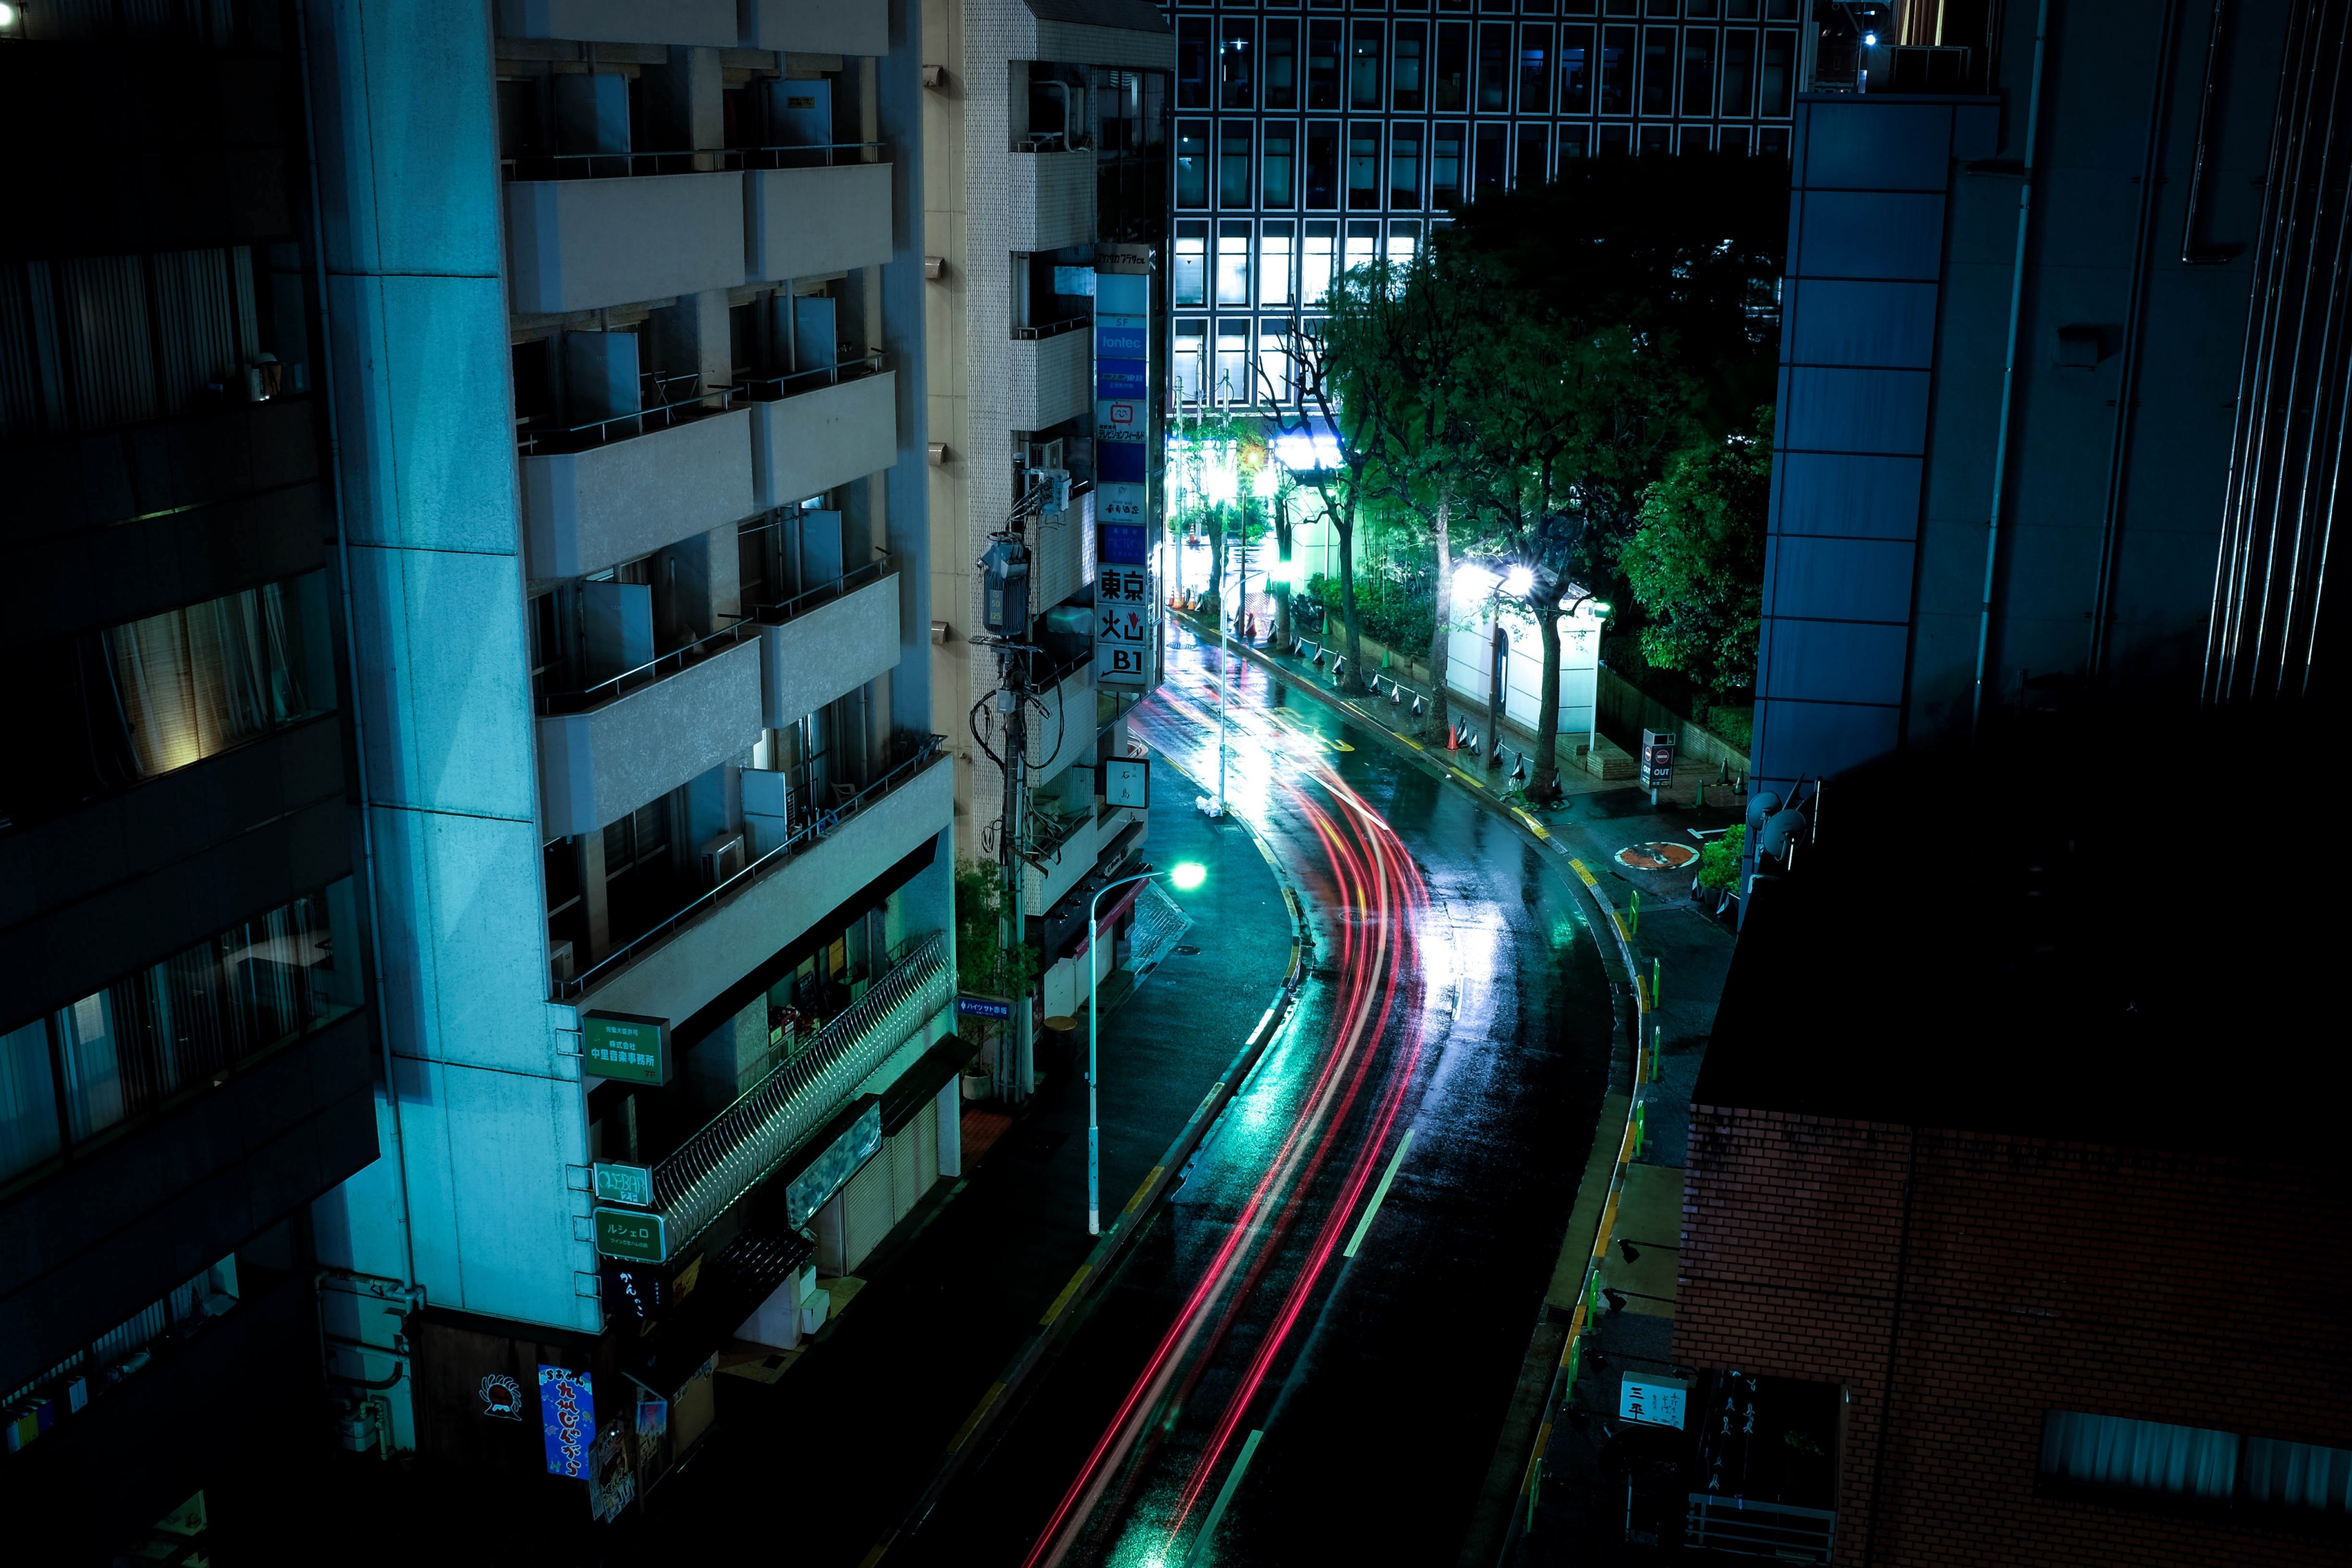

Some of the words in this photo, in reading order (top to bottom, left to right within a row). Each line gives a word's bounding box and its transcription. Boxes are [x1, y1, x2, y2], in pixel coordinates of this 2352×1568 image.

[1116, 318, 1128, 326] 5F
[1099, 429, 1145, 440] テレビジョンフィールド
[1101, 569, 1144, 601] 東京
[1100, 609, 1144, 641] 火山
[1114, 649, 1141, 671] B1
[609, 1040, 636, 1050] 株式会社
[591, 1047, 654, 1067] 中里音楽事務所
[608, 1224, 649, 1238] ルシェロ
[1629, 1387, 1644, 1421] 三平
[556, 1381, 582, 1477] 九州じゃんがら
